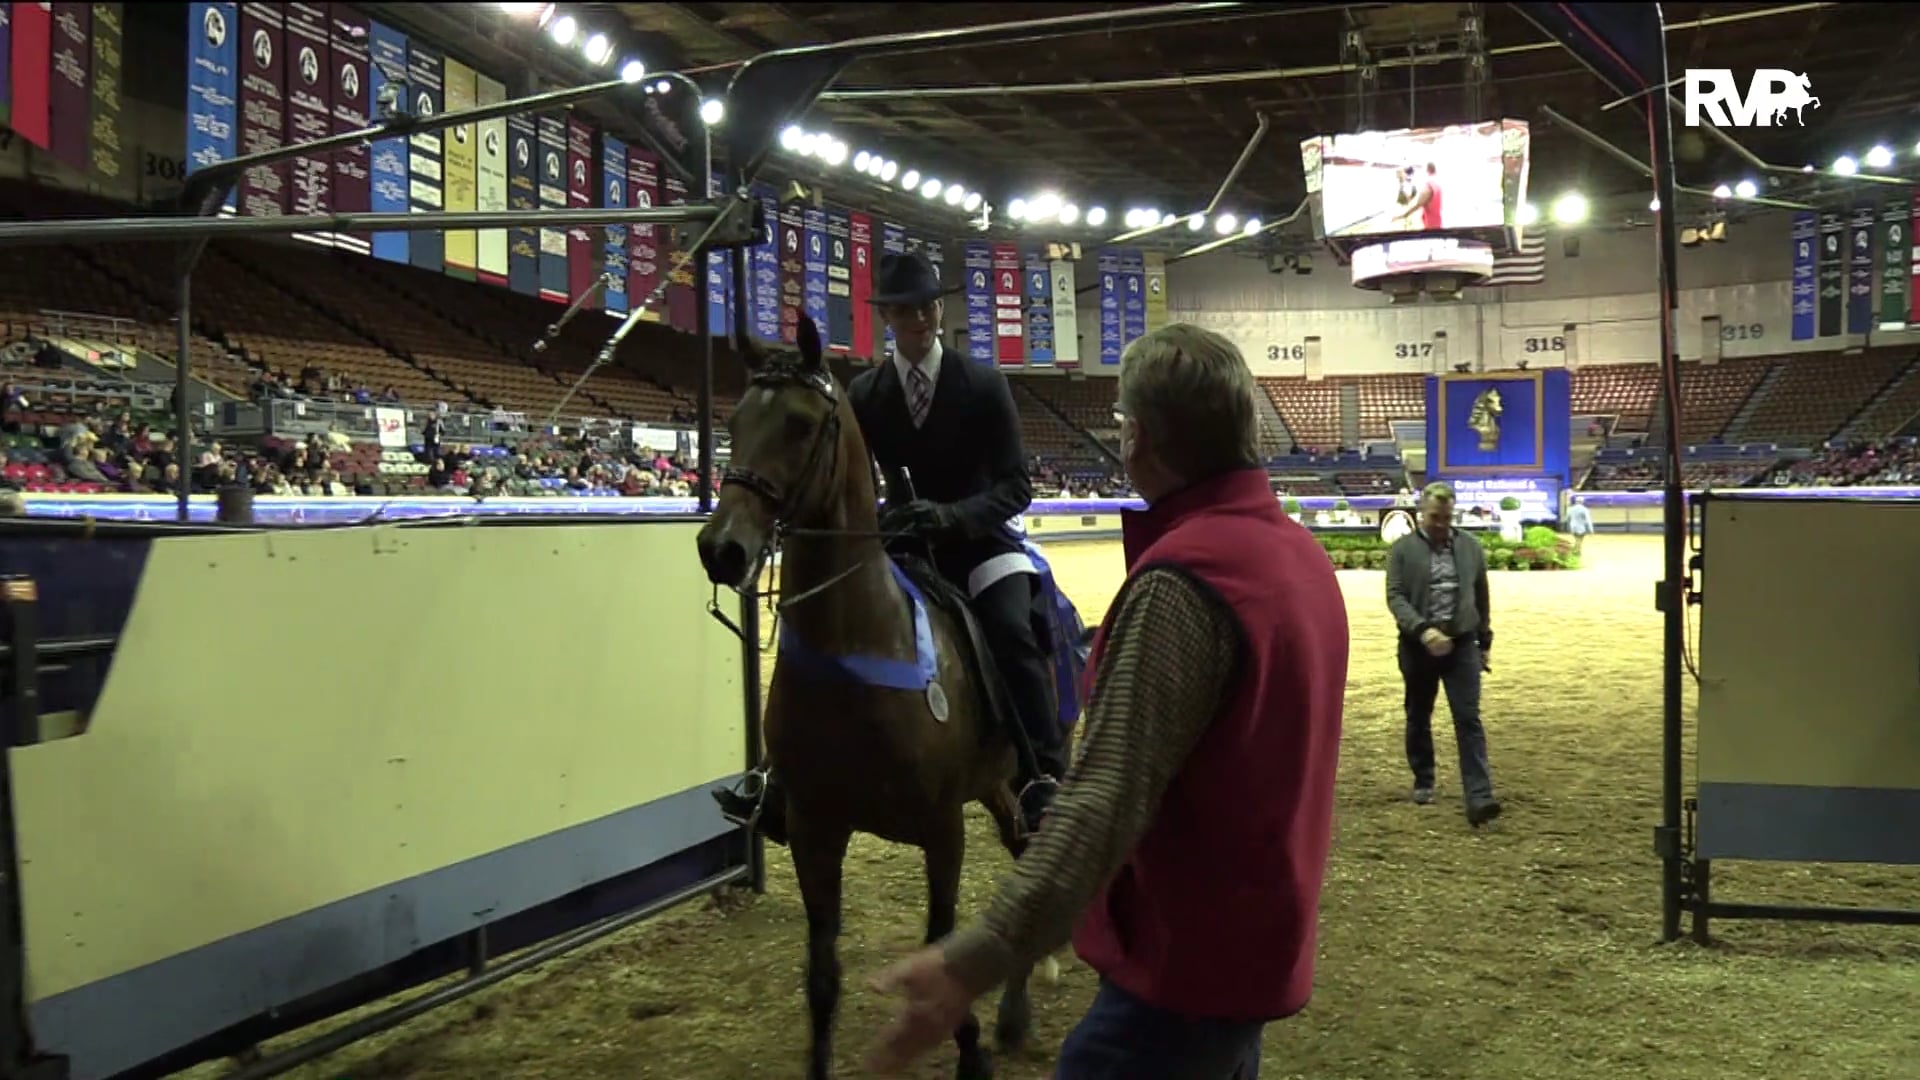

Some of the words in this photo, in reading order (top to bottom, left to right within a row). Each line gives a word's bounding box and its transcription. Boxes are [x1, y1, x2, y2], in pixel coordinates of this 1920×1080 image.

[1721, 323, 1764, 341] 319
[1267, 344, 1304, 361] 316
[1395, 342, 1433, 359] 317
[1525, 336, 1566, 353] 318
